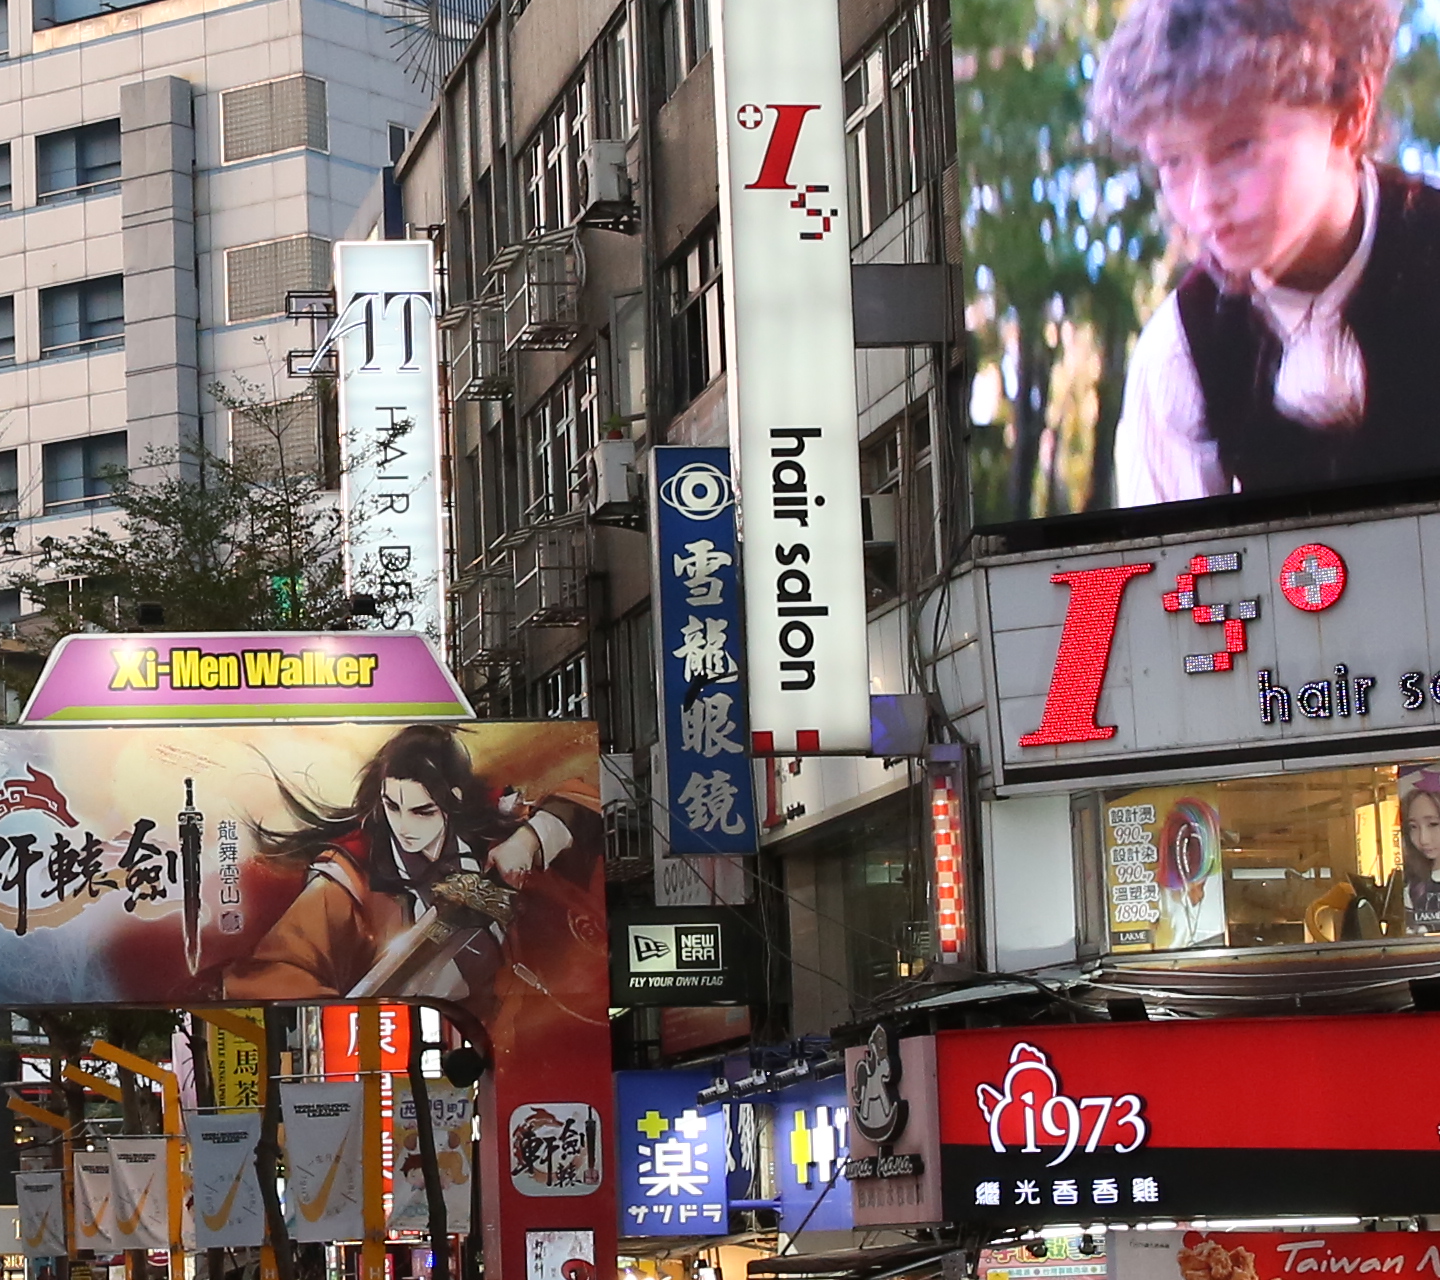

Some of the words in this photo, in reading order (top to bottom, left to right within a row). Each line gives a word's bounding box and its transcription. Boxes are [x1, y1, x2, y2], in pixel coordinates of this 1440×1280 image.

[769, 427, 826, 526] hair
[775, 543, 829, 691] salon
[110, 648, 240, 690] Xi-Men
[245, 649, 375, 689] Walker
[671, 539, 746, 838] 雪龍眼鏡
[1257, 663, 1376, 723] hair
[681, 933, 715, 947] NEW
[681, 948, 715, 961] ERA
[629, 977, 646, 987] FLY
[648, 977, 674, 987] YOUR
[676, 977, 698, 987] OWN
[700, 976, 724, 986] FLAG
[1020, 1091, 1148, 1167] 1973
[975, 1176, 1160, 1206] 繼光香香雞
[628, 1204, 722, 1224] サツドラ
[1276, 1239, 1405, 1274] Taiwan
